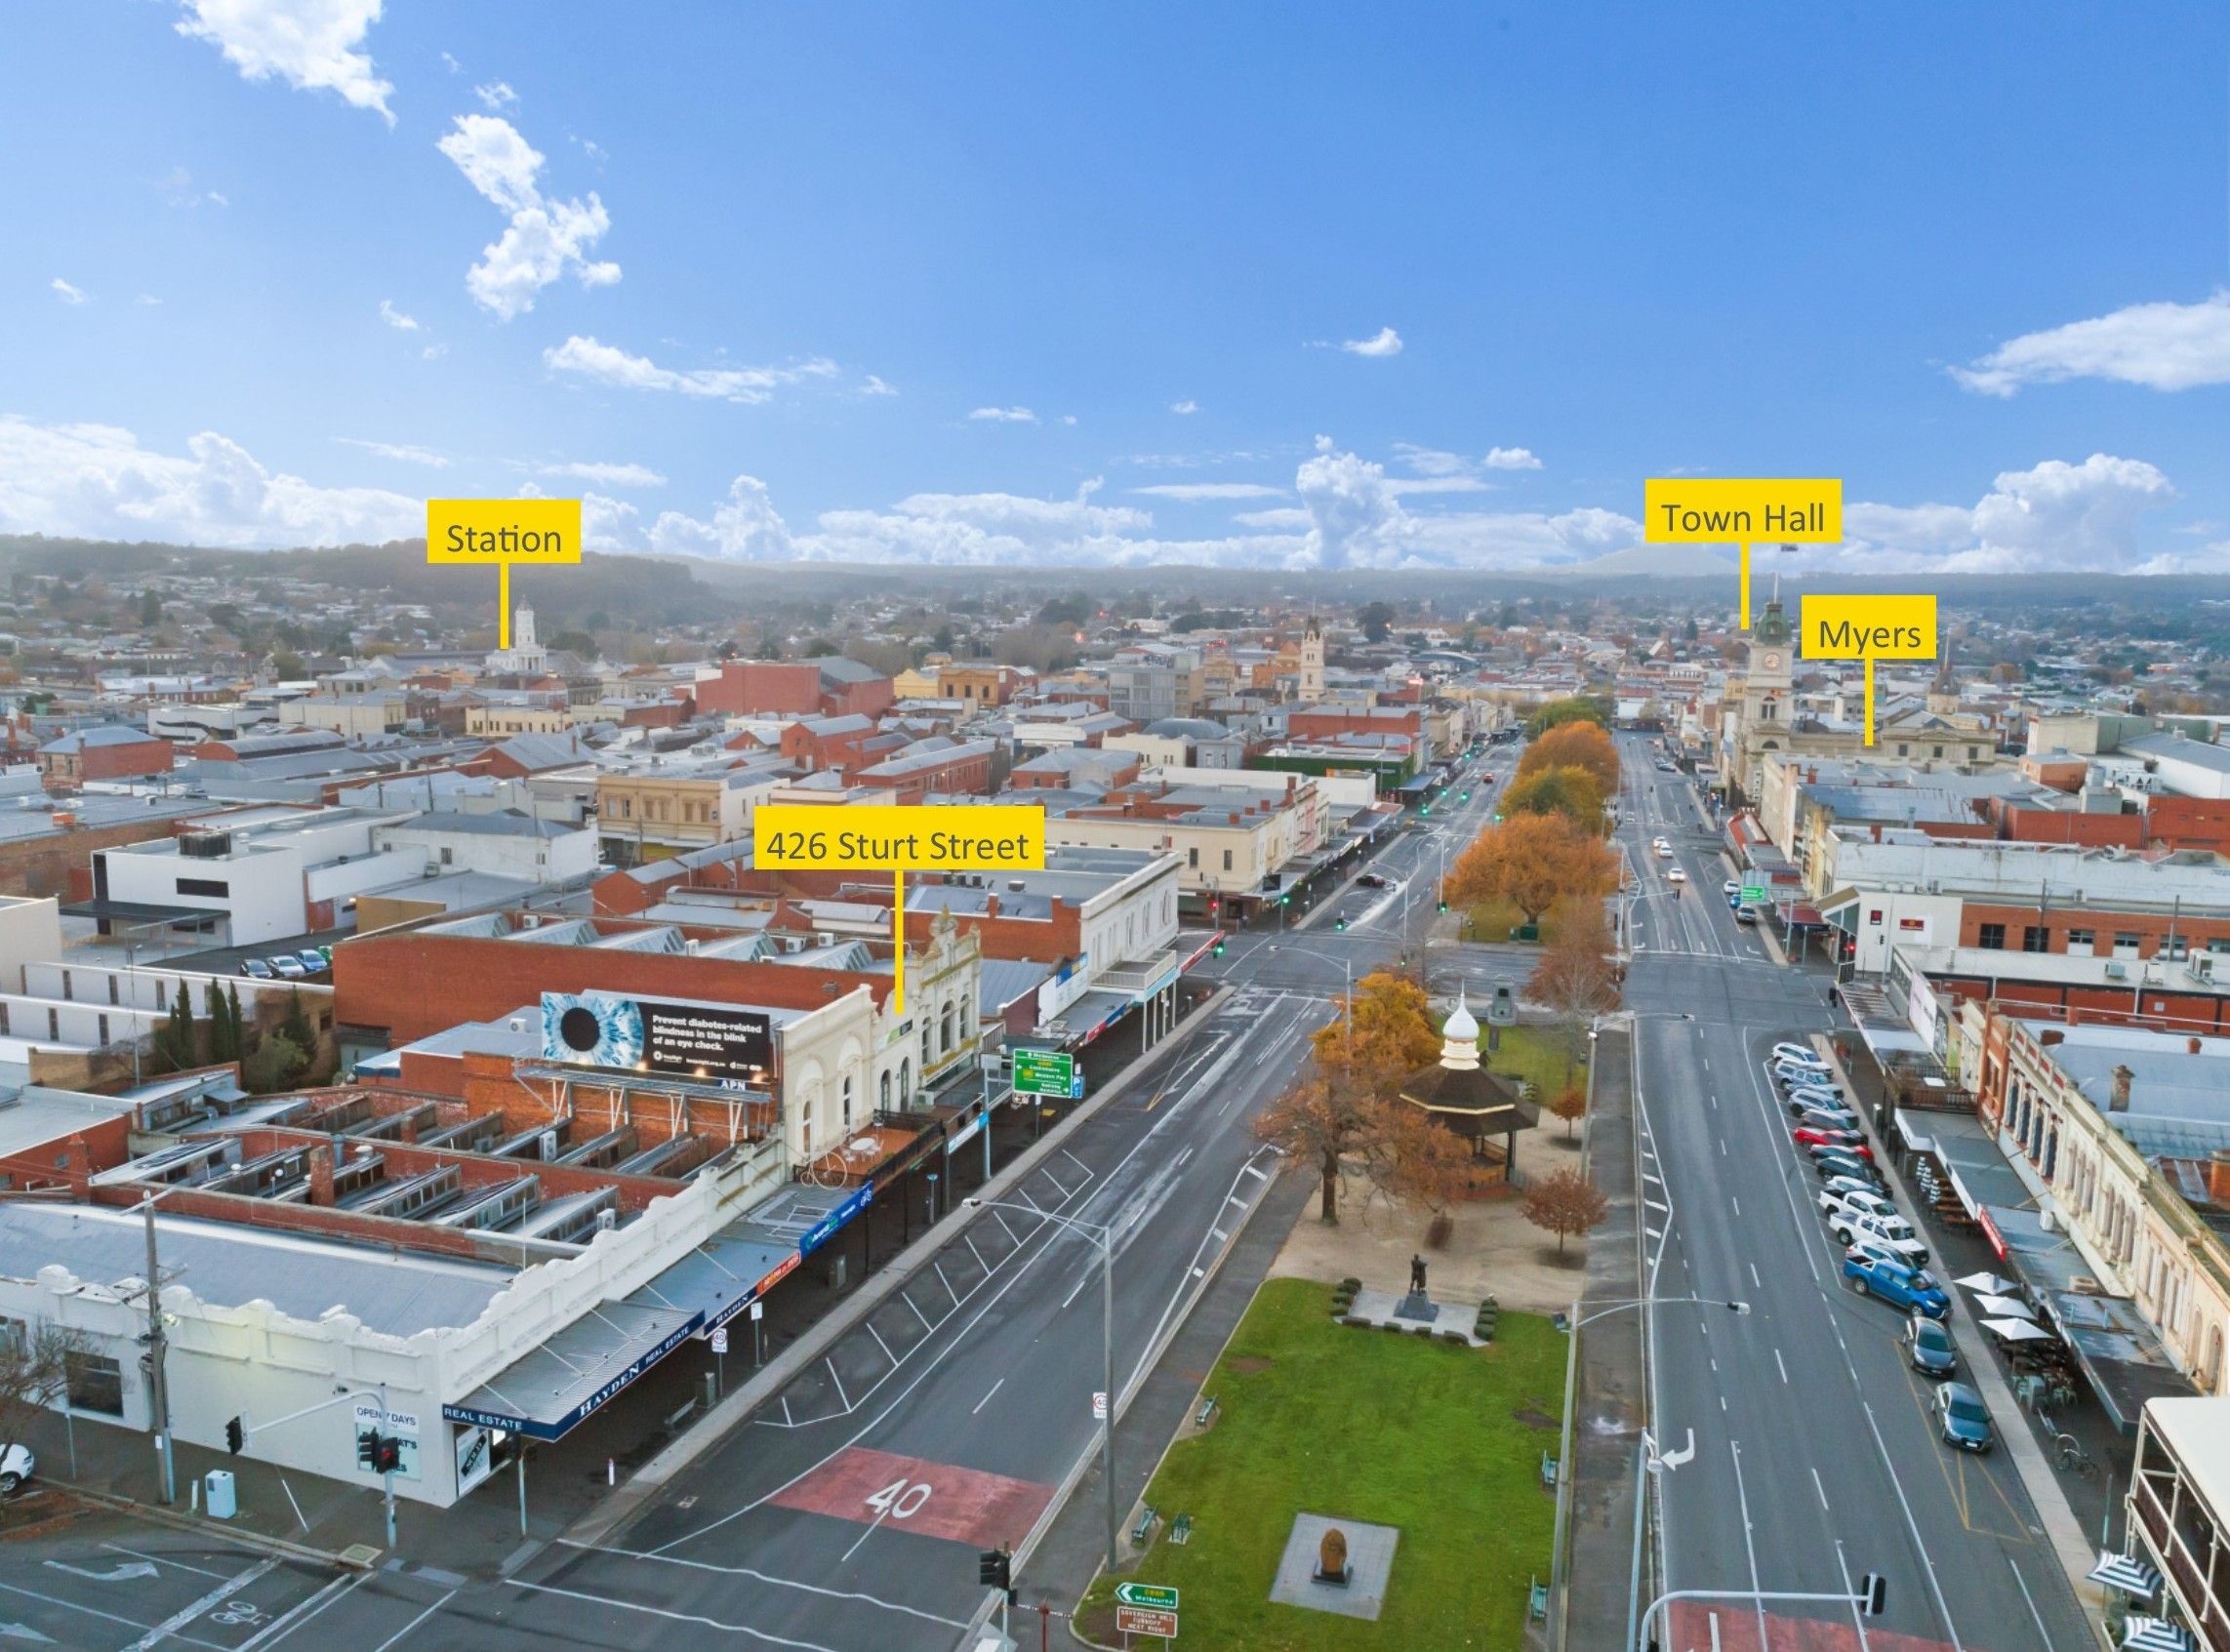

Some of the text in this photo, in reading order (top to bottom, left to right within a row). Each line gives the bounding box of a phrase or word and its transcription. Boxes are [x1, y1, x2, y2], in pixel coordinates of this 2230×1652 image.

[652, 1015, 762, 1034] Prevent diabetes-related
[652, 1026, 747, 1043] blindness in the blink
[652, 1036, 663, 1045] of
[676, 1040, 694, 1049] eye
[695, 1041, 724, 1051] check.
[719, 1079, 746, 1091] APN
[579, 1326, 690, 1417] HAYDEN REAL ESTATE
[391, 1412, 417, 1426] DAYS
[444, 1407, 523, 1431] REAL ESTATE
[865, 1478, 933, 1519] 40
[1135, 1594, 1174, 1605] Melbourne
